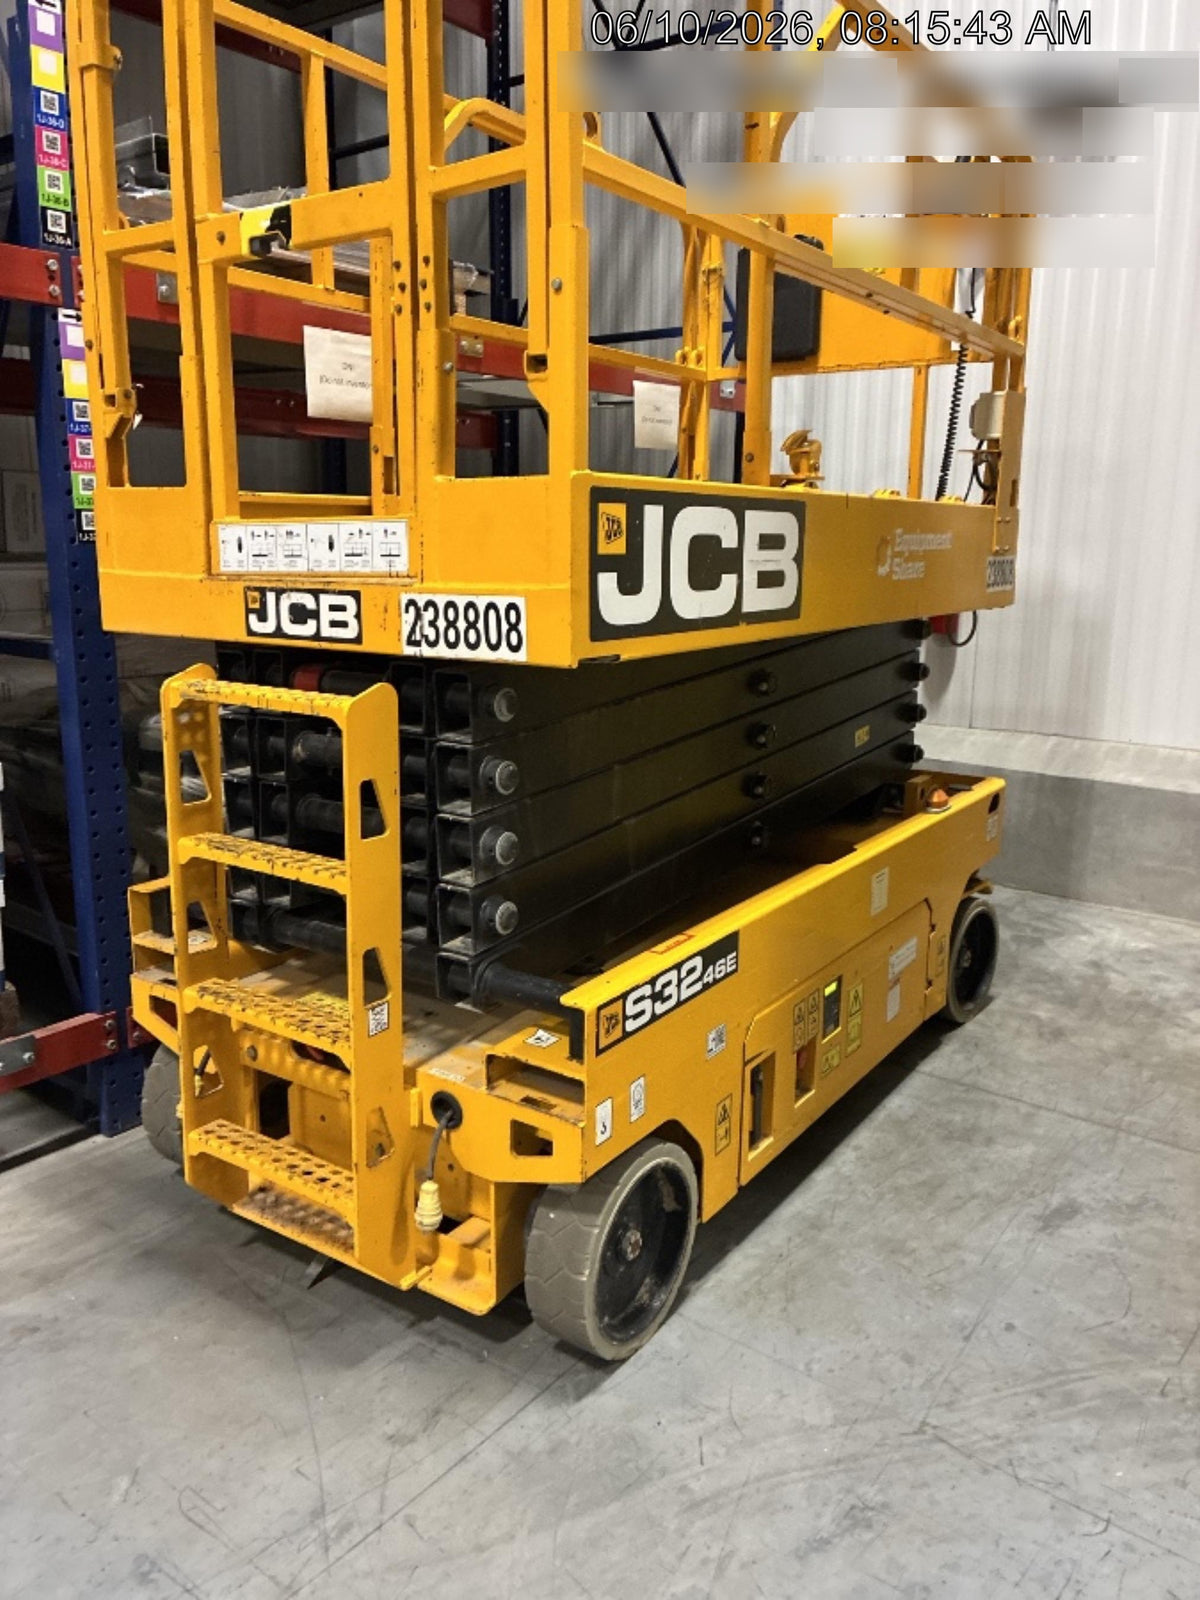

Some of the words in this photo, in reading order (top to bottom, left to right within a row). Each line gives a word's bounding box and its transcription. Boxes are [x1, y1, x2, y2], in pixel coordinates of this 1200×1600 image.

[597, 503, 800, 626] JCB
[248, 591, 358, 640] JCB
[404, 598, 524, 653] 238808
